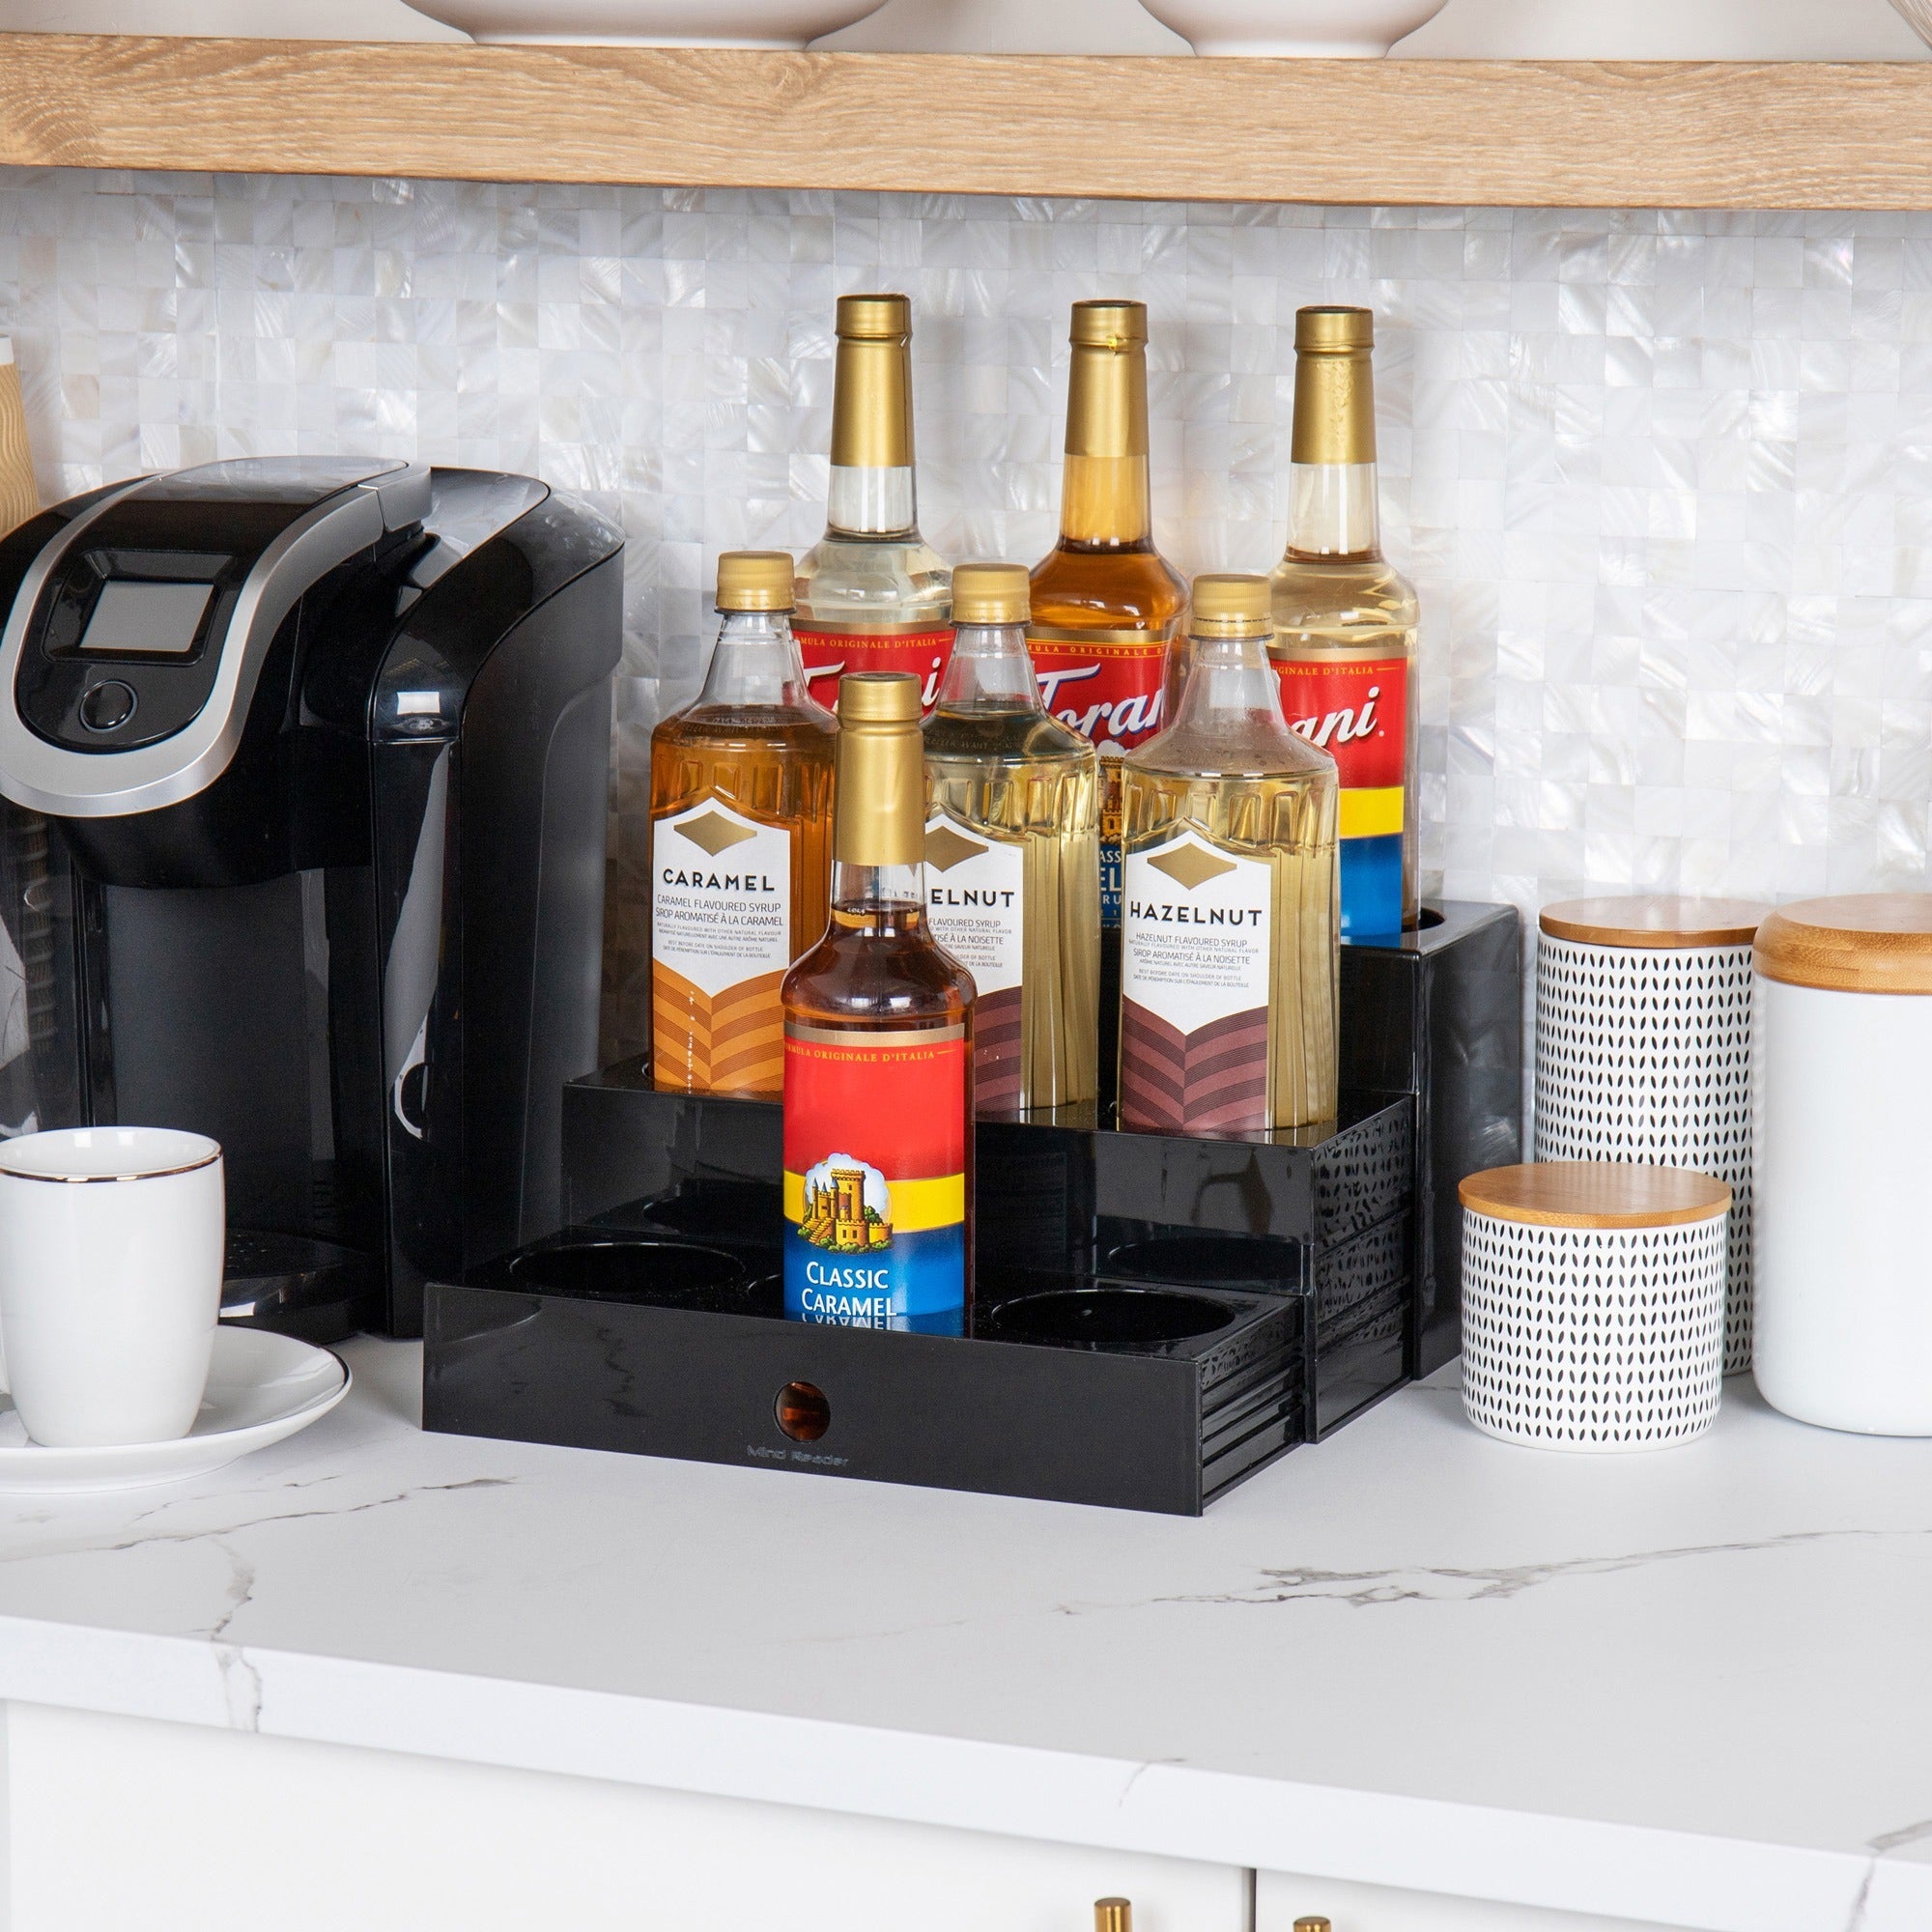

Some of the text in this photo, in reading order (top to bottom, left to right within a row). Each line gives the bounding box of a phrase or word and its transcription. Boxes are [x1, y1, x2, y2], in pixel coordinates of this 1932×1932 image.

[801, 637, 937, 649] MULA ORIGINALE D'ITALIA
[1070, 646, 1148, 656] ORIGINALE
[1278, 667, 1374, 675] GINALE D'ITALIA
[663, 868, 775, 892] CARAMEL
[657, 894, 781, 913] CARAMEL FLAVOURED SYRUP
[931, 888, 1014, 908] ELNUT
[655, 907, 783, 926] SIROP AROMATISÉ À LA CARAMEL
[1130, 900, 1263, 926] HAZELNUT
[928, 918, 1001, 928] FLAVOURED SYRUP
[950, 933, 956, 943] À
[957, 934, 967, 943] LA
[968, 936, 1004, 945] NOISETTE
[1135, 932, 1247, 948] HAZELNUT FLAVOURED SYRUP
[1133, 948, 1151, 957] SIROP
[1152, 951, 1194, 961] AROMATISÉ
[1195, 952, 1201, 962] À
[1213, 954, 1250, 965] NOISETTE
[814, 1049, 877, 1062] ORIGINALE
[883, 1051, 934, 1062] D'ITALIA
[806, 1261, 889, 1290] CLASSIC
[801, 1288, 897, 1317] CARAMEL
